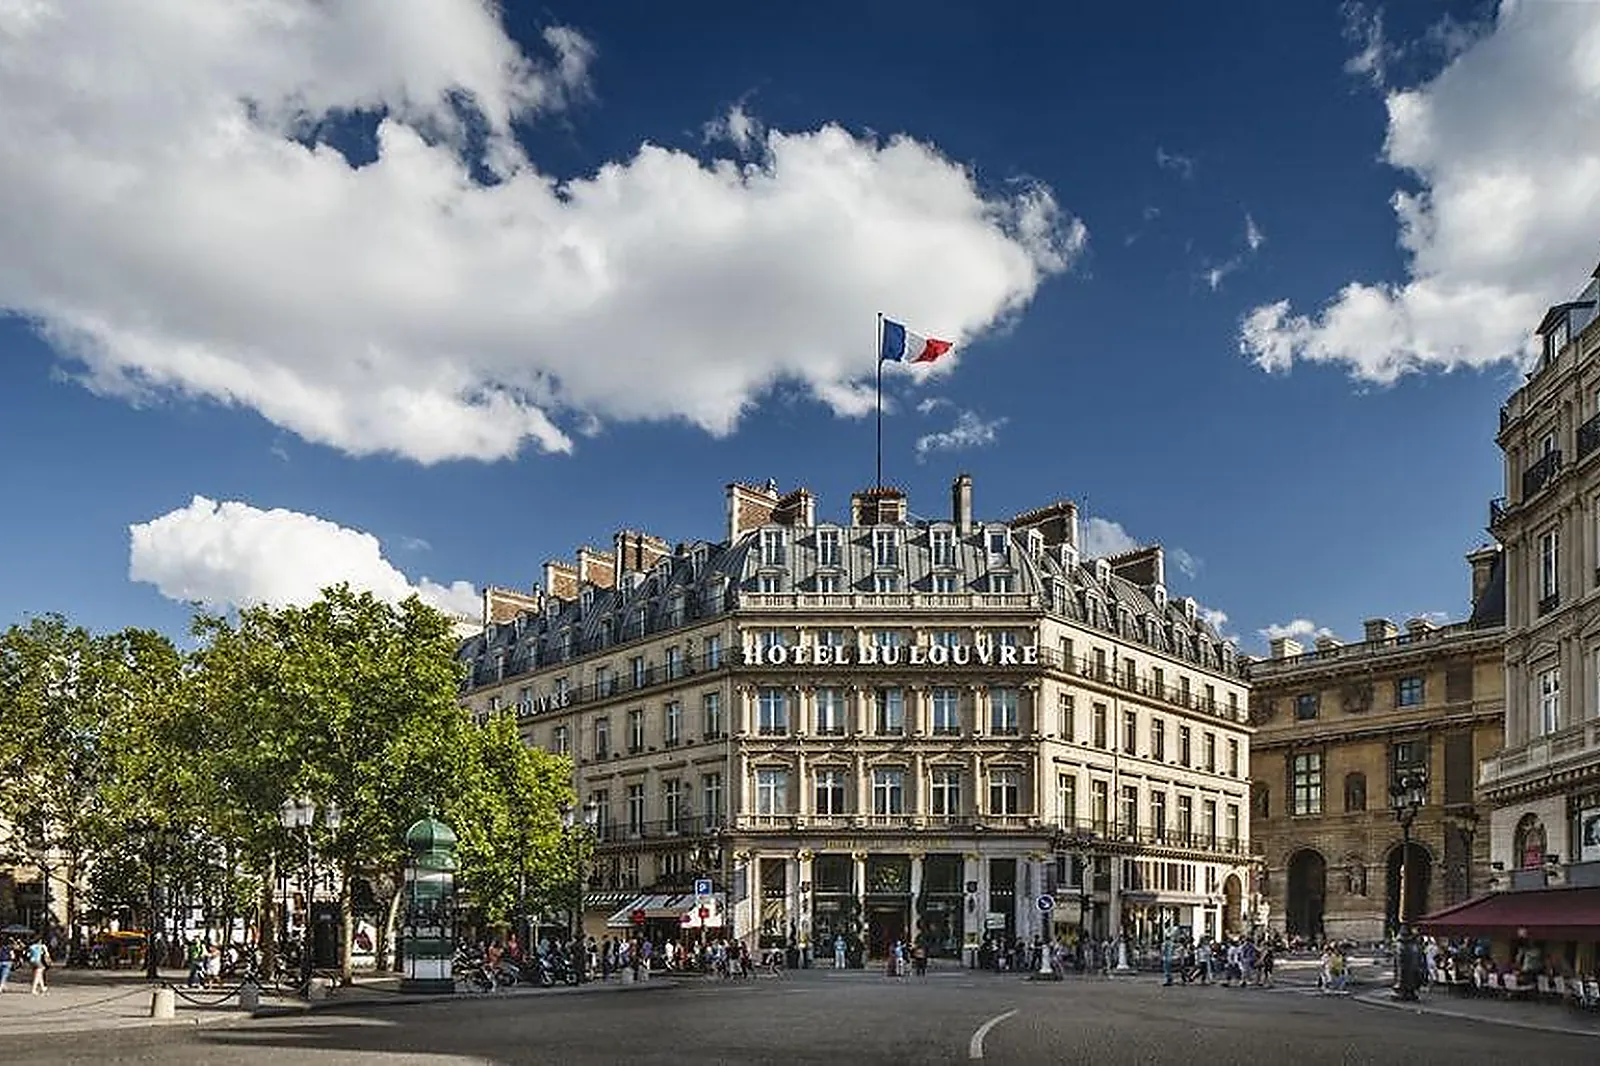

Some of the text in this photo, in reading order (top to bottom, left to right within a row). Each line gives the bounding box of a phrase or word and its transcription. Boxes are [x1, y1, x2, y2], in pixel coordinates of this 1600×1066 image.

[743, 645, 1038, 664] HOTEL DU LOUVRE
